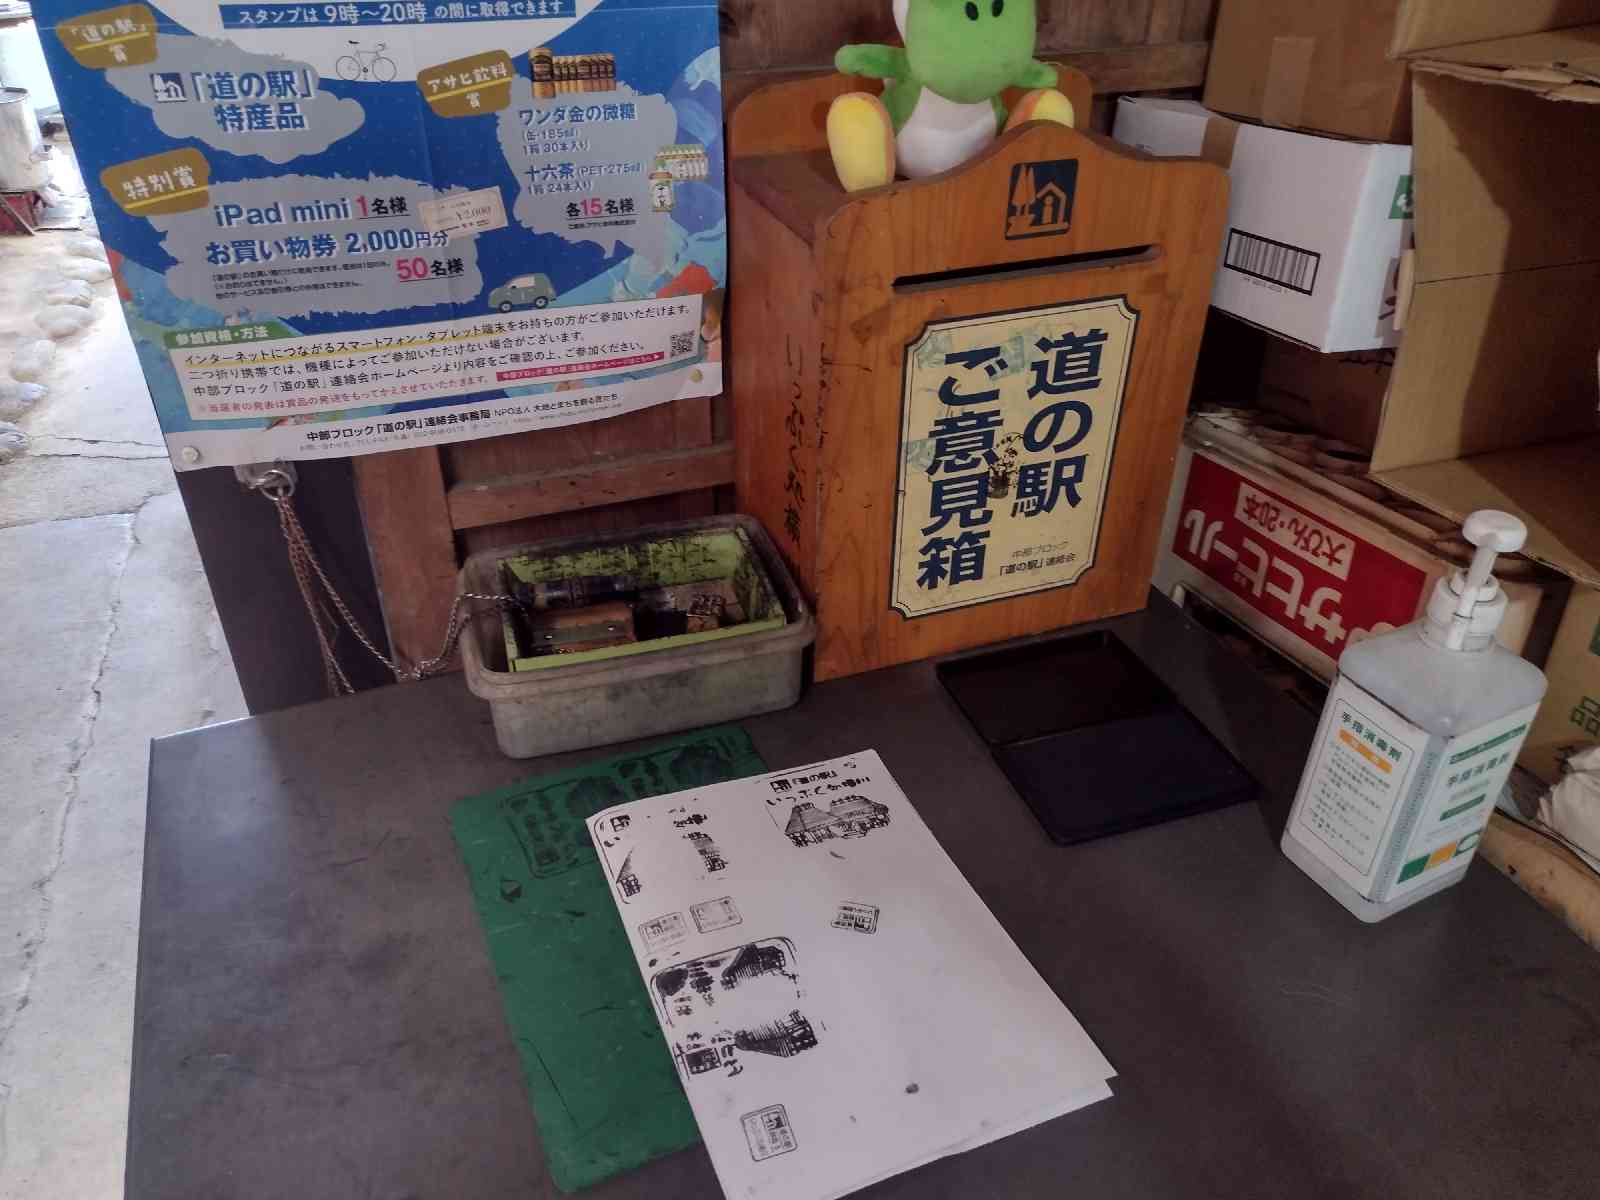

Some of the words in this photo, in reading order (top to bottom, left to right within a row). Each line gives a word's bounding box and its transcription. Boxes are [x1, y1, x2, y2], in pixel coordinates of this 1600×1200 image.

[72, 18, 146, 42] 「道の駅」
[193, 71, 314, 101] 「道の駅」
[427, 61, 507, 92] アサヒ飲料
[215, 104, 306, 132] 特産品
[519, 103, 637, 125] ワンダ金の微糖
[122, 166, 198, 200] 特別賞
[525, 162, 575, 182] 十六茶
[214, 202, 283, 228] iPad
[291, 197, 349, 223] mini
[356, 195, 408, 218] 1名様
[566, 197, 634, 218] 各15名様
[207, 233, 337, 265] お買い物券
[345, 228, 449, 254] 2,000円分
[395, 256, 465, 280] 50名様
[1010, 328, 1108, 518] 道の駅
[916, 346, 1009, 590] ご意見箱
[1184, 508, 1397, 646] サヒビール
